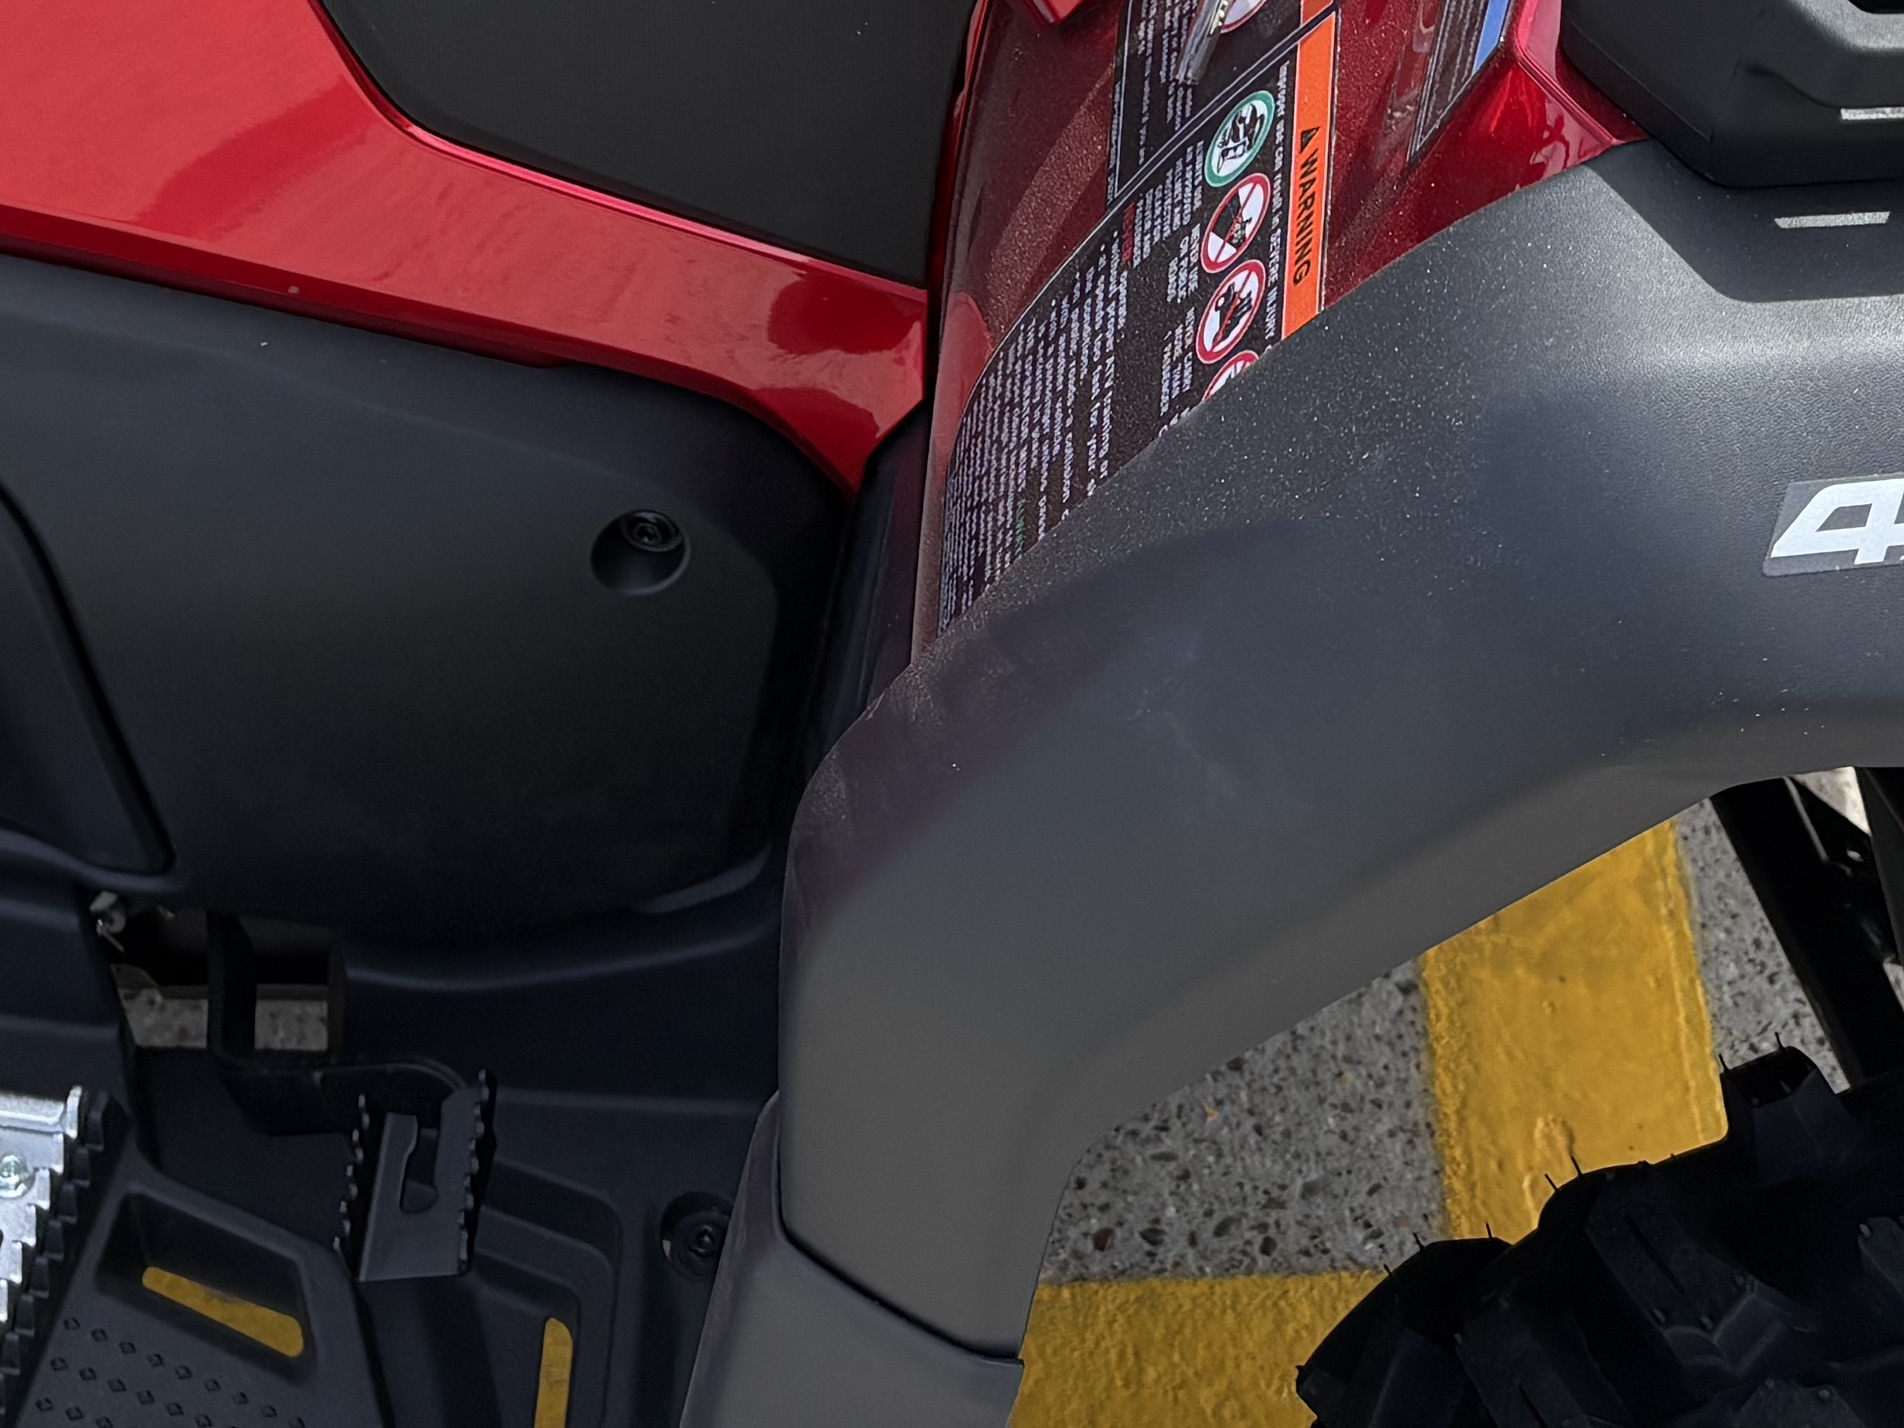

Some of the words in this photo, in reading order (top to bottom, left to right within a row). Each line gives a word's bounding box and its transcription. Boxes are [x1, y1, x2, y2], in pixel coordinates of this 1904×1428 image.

[1291, 146, 1318, 289] WARNING
[1266, 226, 1281, 288] SEVERE
[1263, 284, 1278, 344] INJURY
[1104, 352, 1115, 390] ATV
